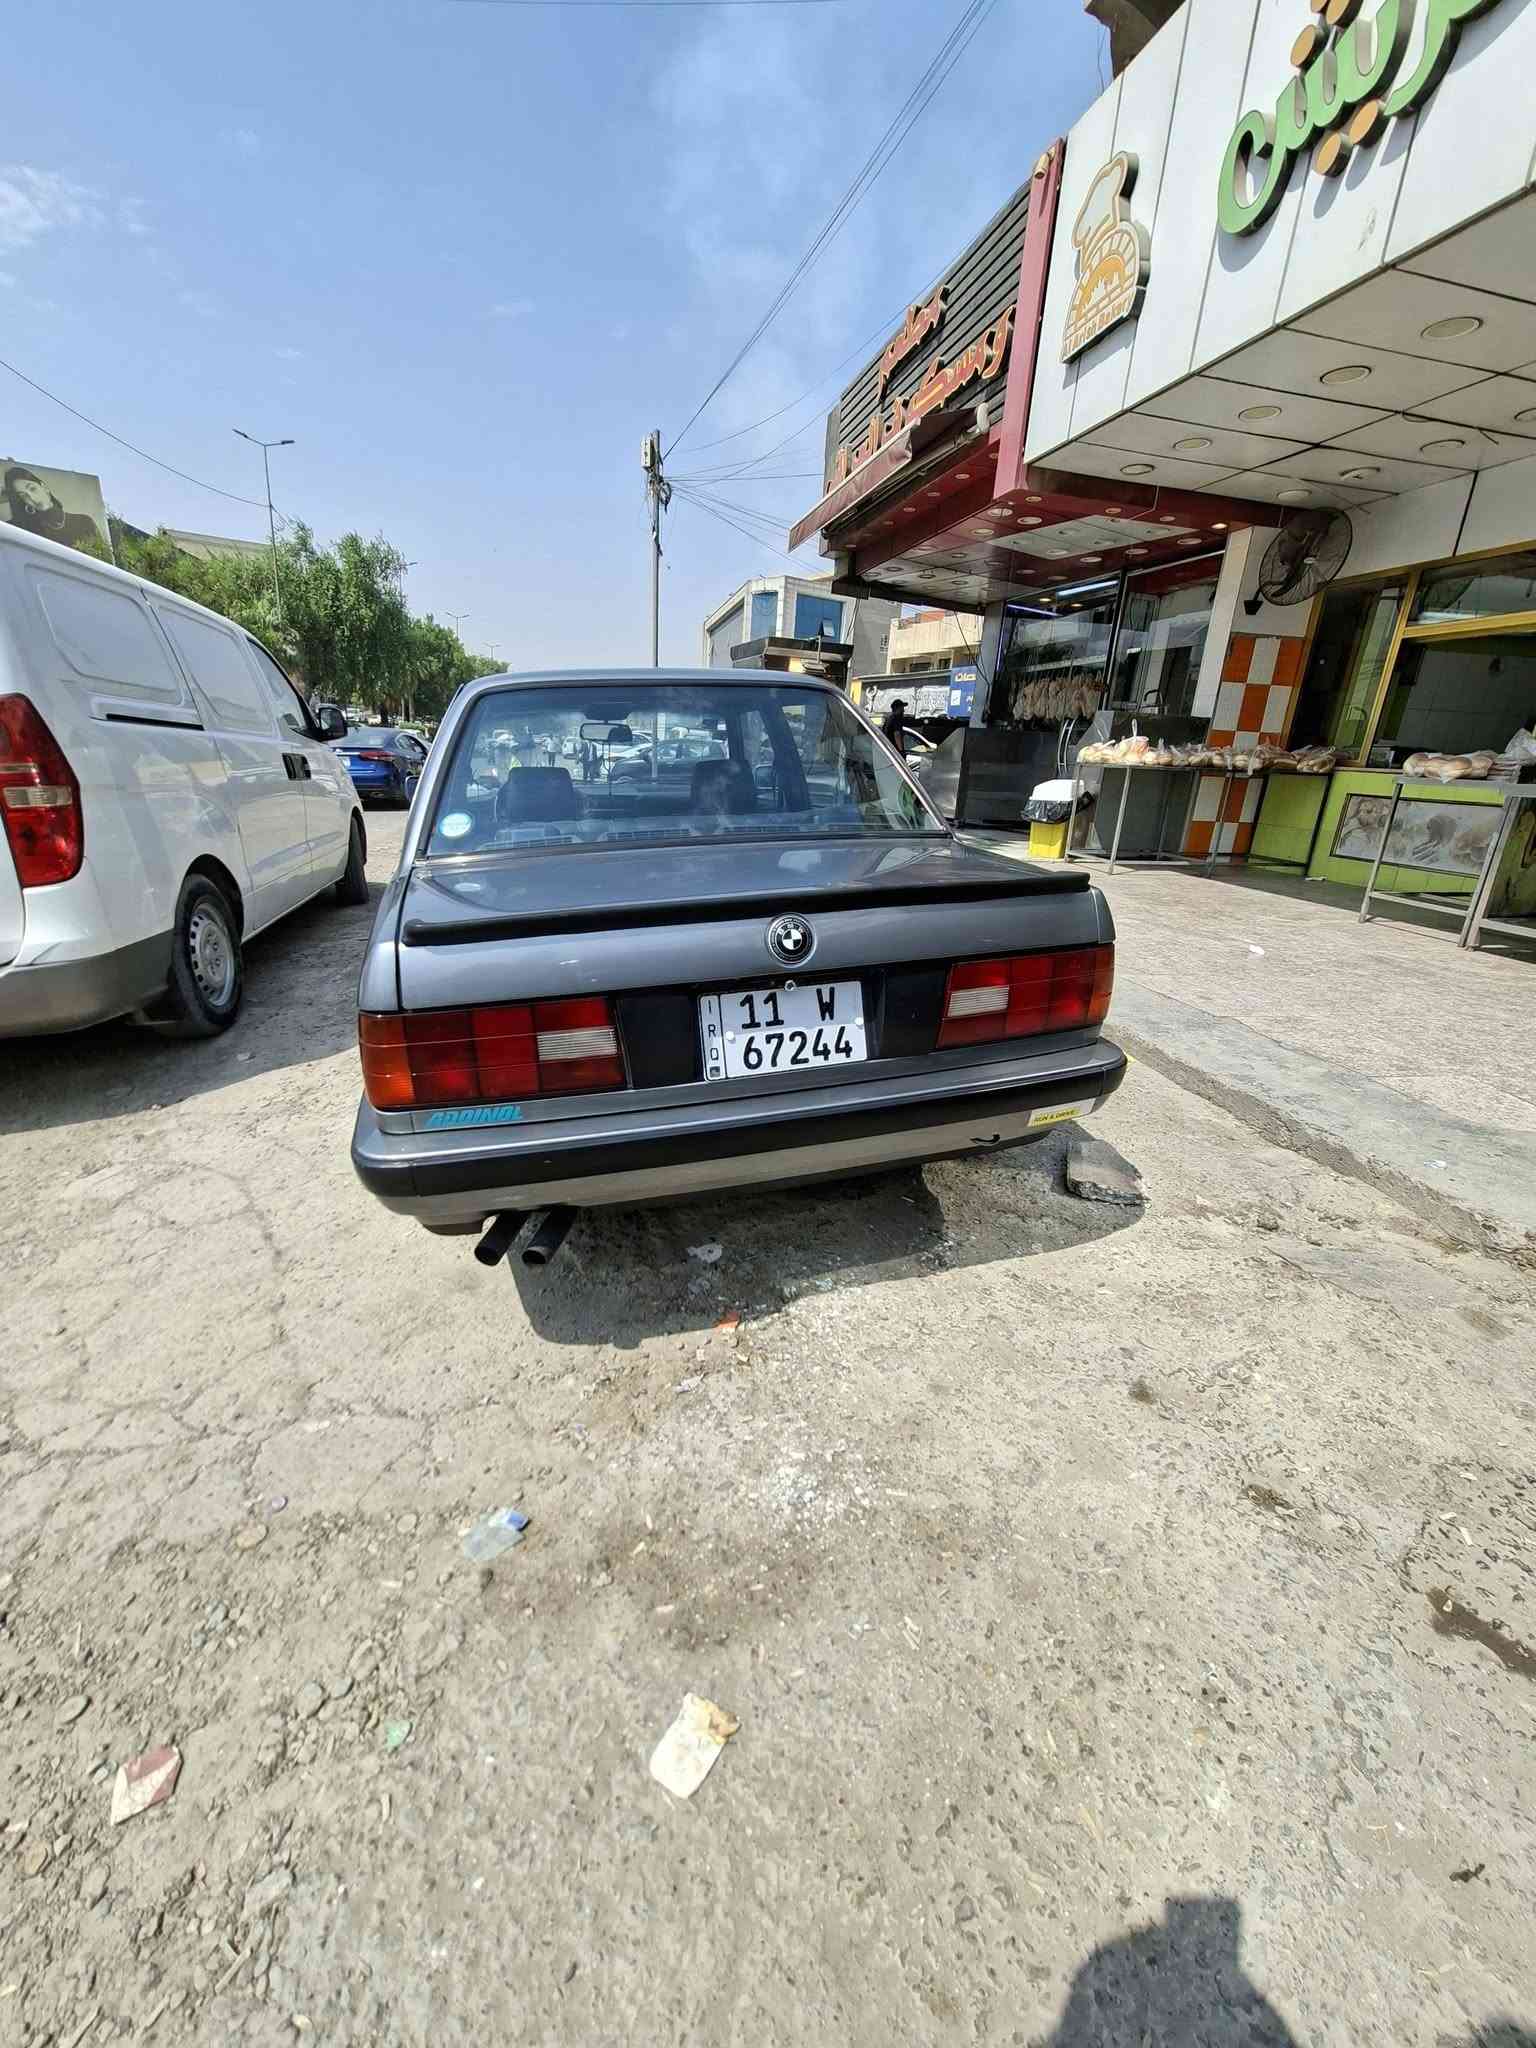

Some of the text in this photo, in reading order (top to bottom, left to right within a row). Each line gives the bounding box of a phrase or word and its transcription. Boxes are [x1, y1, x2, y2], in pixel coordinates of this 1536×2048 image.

[740, 987, 836, 1029] 11 W
[743, 1026, 853, 1070] 67244
